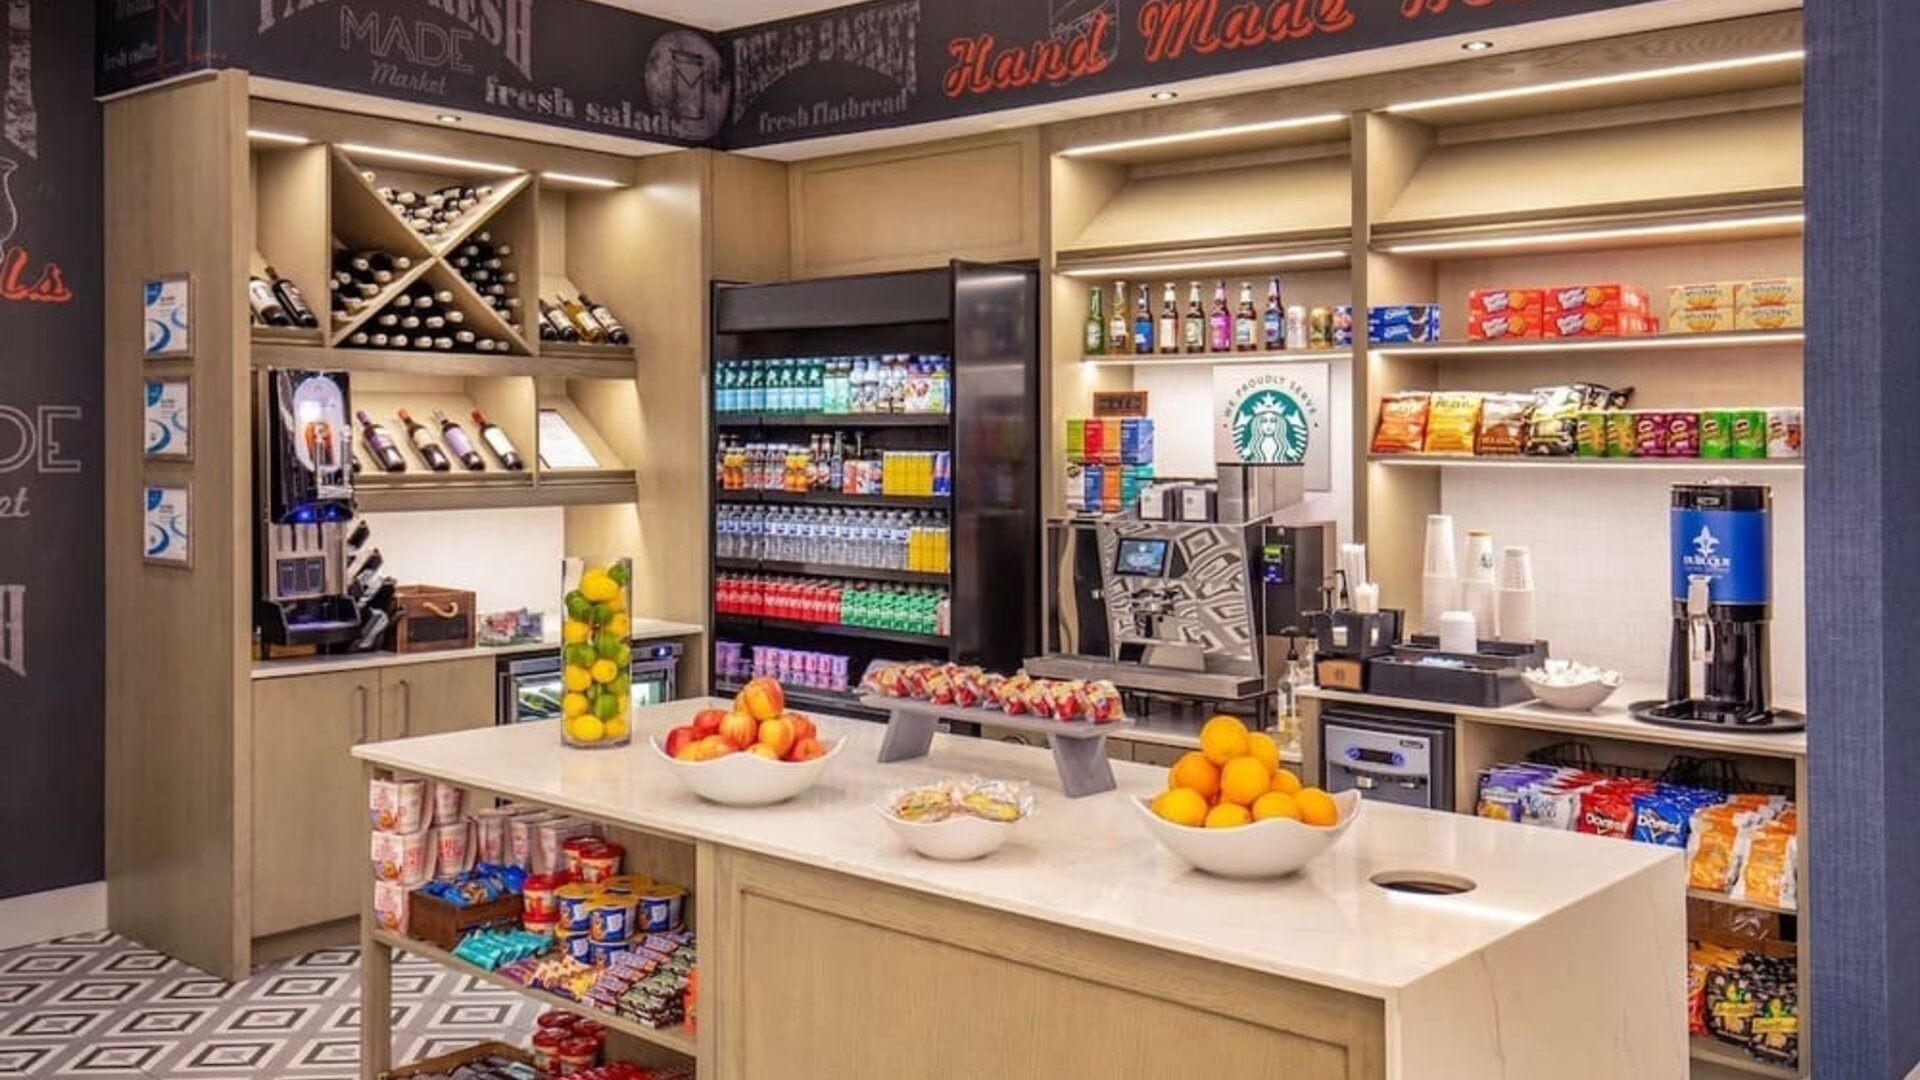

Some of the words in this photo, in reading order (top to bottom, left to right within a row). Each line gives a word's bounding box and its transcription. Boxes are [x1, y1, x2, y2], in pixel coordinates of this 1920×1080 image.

[340, 4, 474, 74] MADE
[943, 12, 1111, 97] Hand
[1137, 0, 1355, 62] Made
[370, 60, 448, 95] Market
[484, 75, 576, 118] fresh
[758, 103, 810, 134] fresh
[812, 87, 908, 127] flatbread
[1224, 400, 1236, 418] WE
[1235, 374, 1286, 397] PROUDLY
[1289, 381, 1318, 415] SERVE
